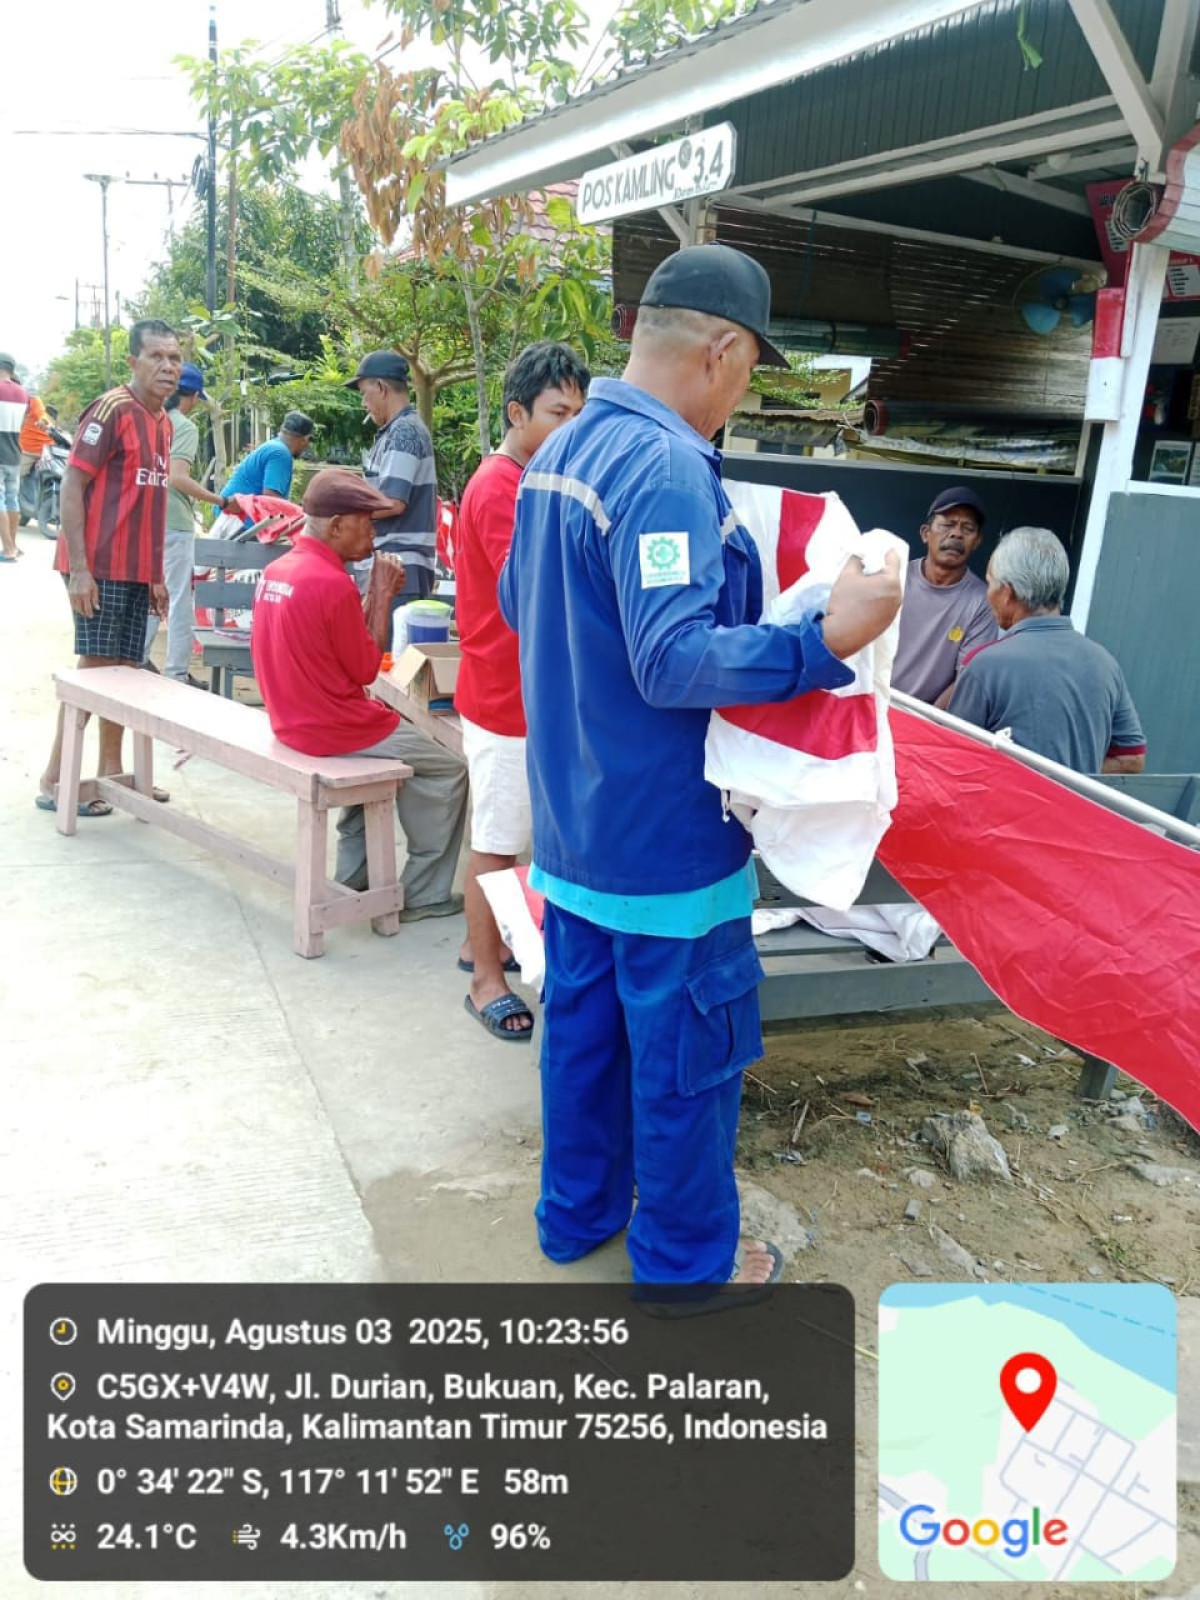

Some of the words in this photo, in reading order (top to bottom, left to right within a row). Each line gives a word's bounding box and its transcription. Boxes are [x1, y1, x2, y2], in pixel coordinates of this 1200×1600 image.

[582, 175, 612, 213] POS
[615, 155, 676, 206] KAMLING
[693, 140, 724, 184] 3.4
